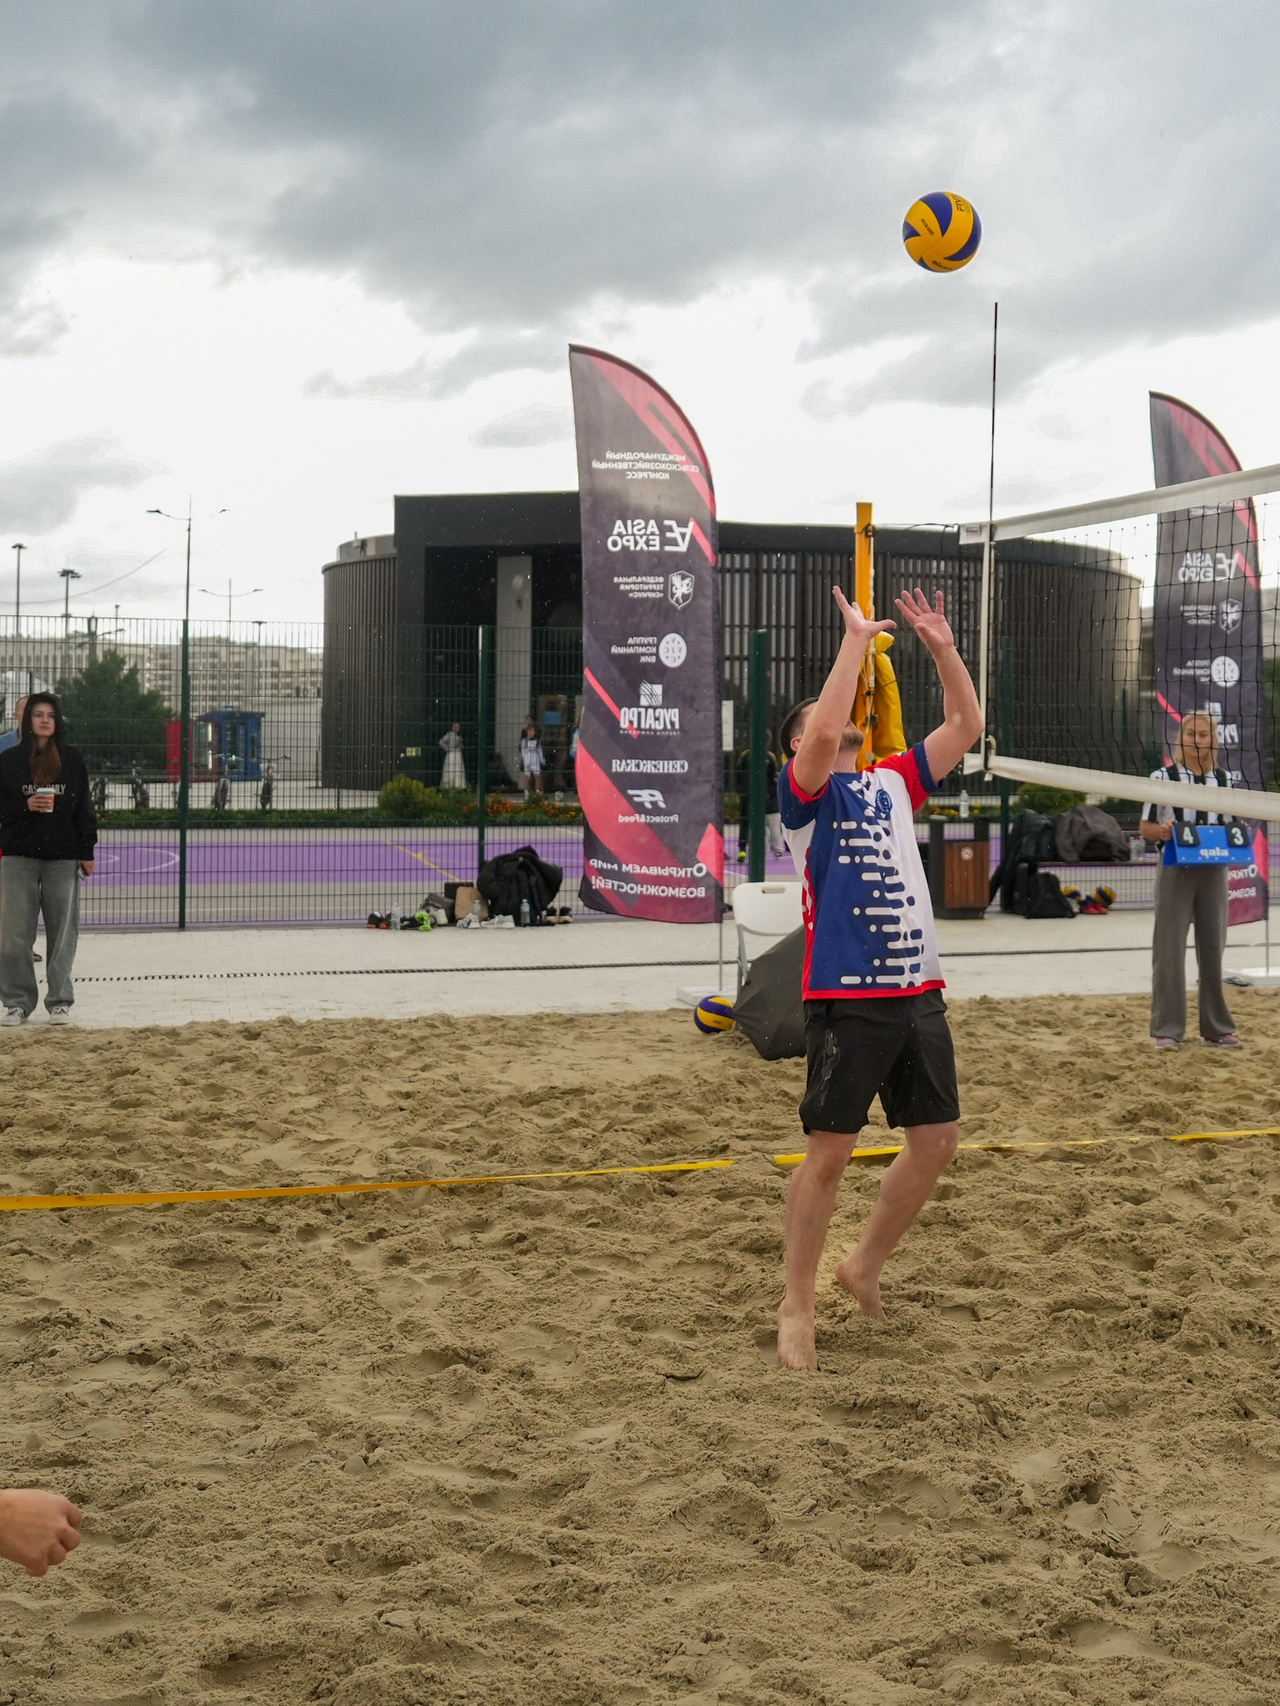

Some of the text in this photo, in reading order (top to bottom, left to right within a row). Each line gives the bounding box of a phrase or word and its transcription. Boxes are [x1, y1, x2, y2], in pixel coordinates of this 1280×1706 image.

[22, 784, 44, 795] CAS
[1182, 826, 1194, 845] 4
[1231, 826, 1245, 845] 3
[1199, 846, 1229, 859] gala
